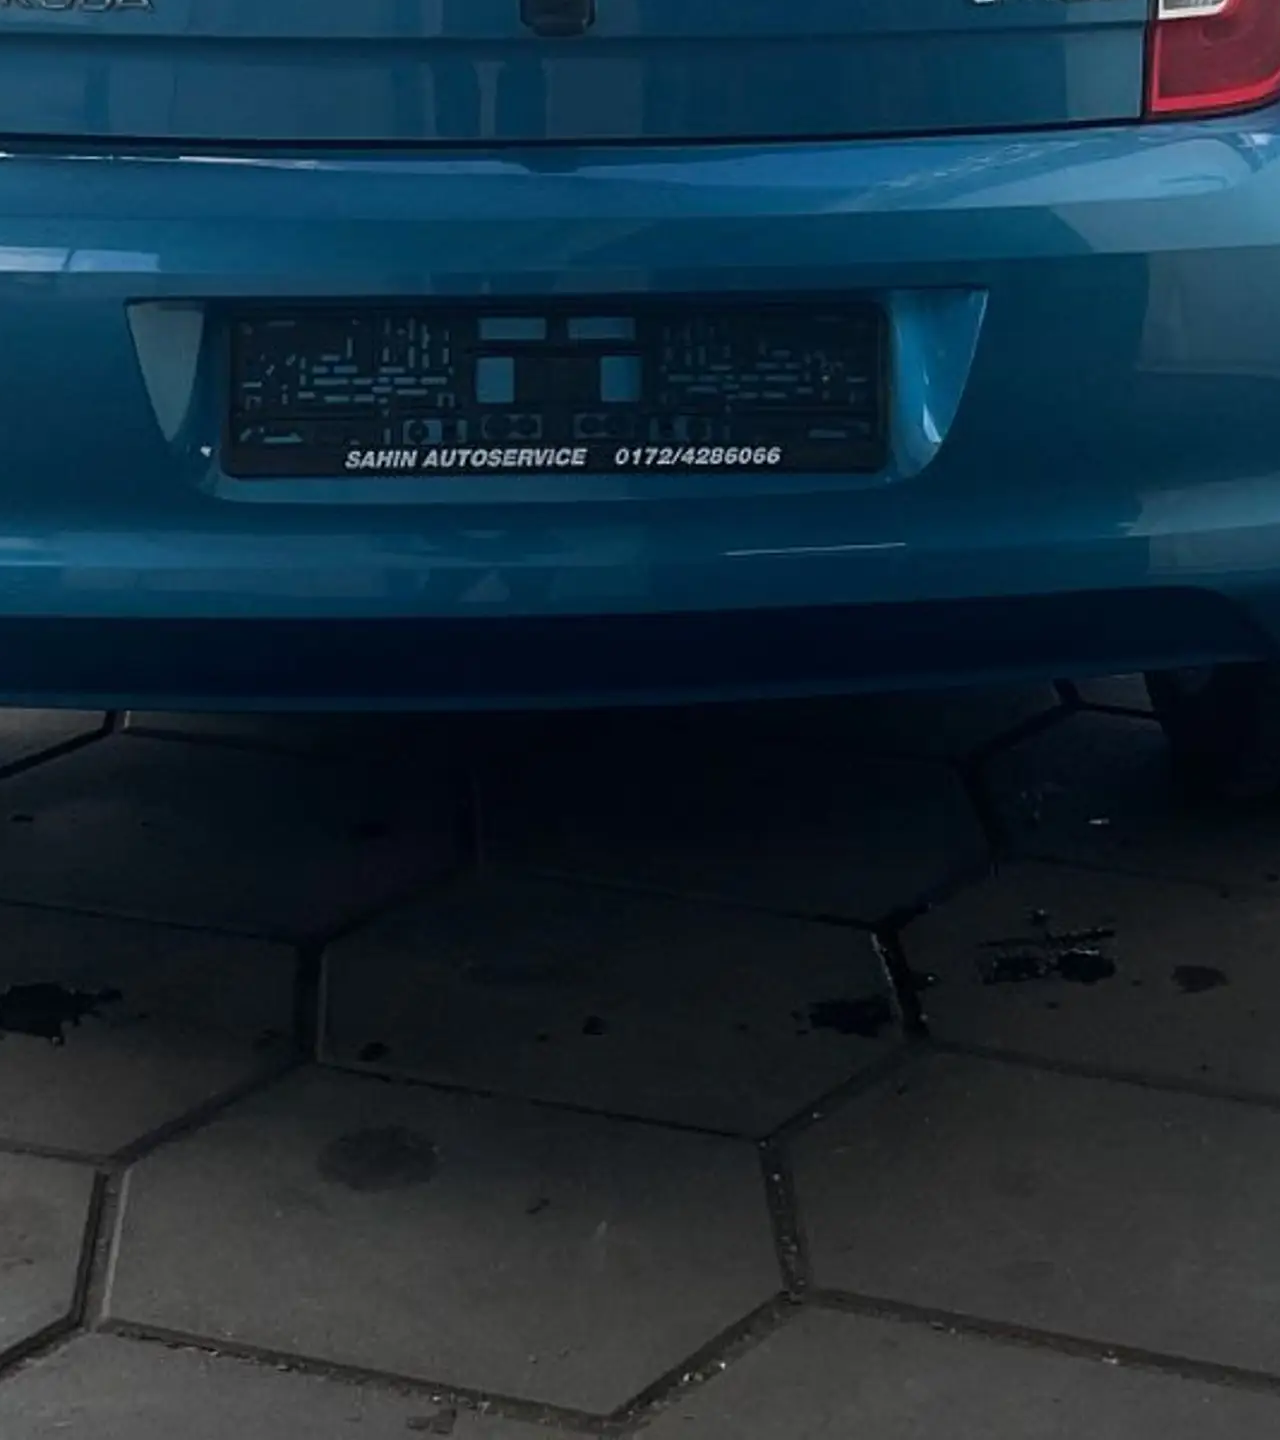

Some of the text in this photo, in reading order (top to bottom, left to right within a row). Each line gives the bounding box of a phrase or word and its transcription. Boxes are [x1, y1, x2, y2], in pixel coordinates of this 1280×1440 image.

[345, 447, 782, 470] SAHIN AUTOSERVICE 0172/4286066
